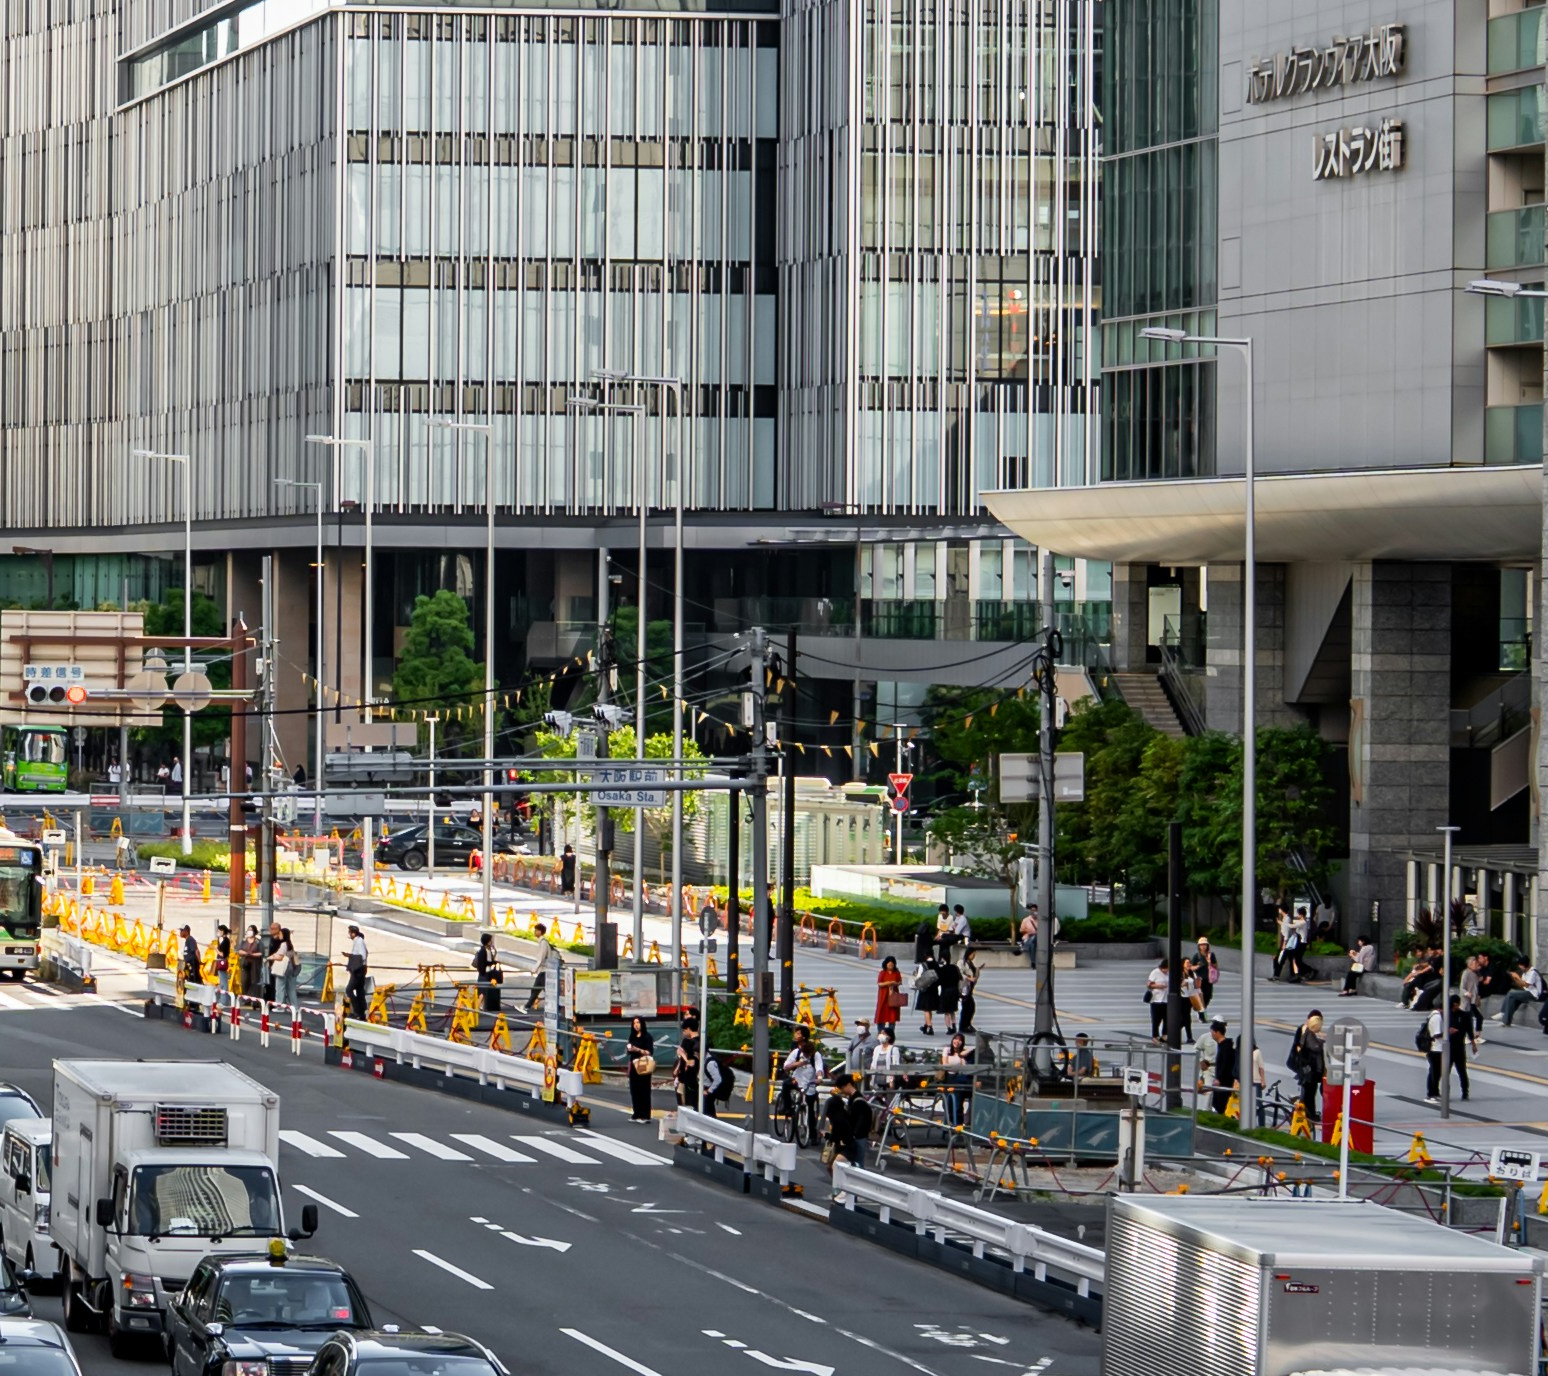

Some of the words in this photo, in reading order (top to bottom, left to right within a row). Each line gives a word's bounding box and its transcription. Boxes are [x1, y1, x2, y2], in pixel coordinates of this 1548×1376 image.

[1312, 118, 1402, 181] レストラン街
[597, 790, 632, 802] Osaka
